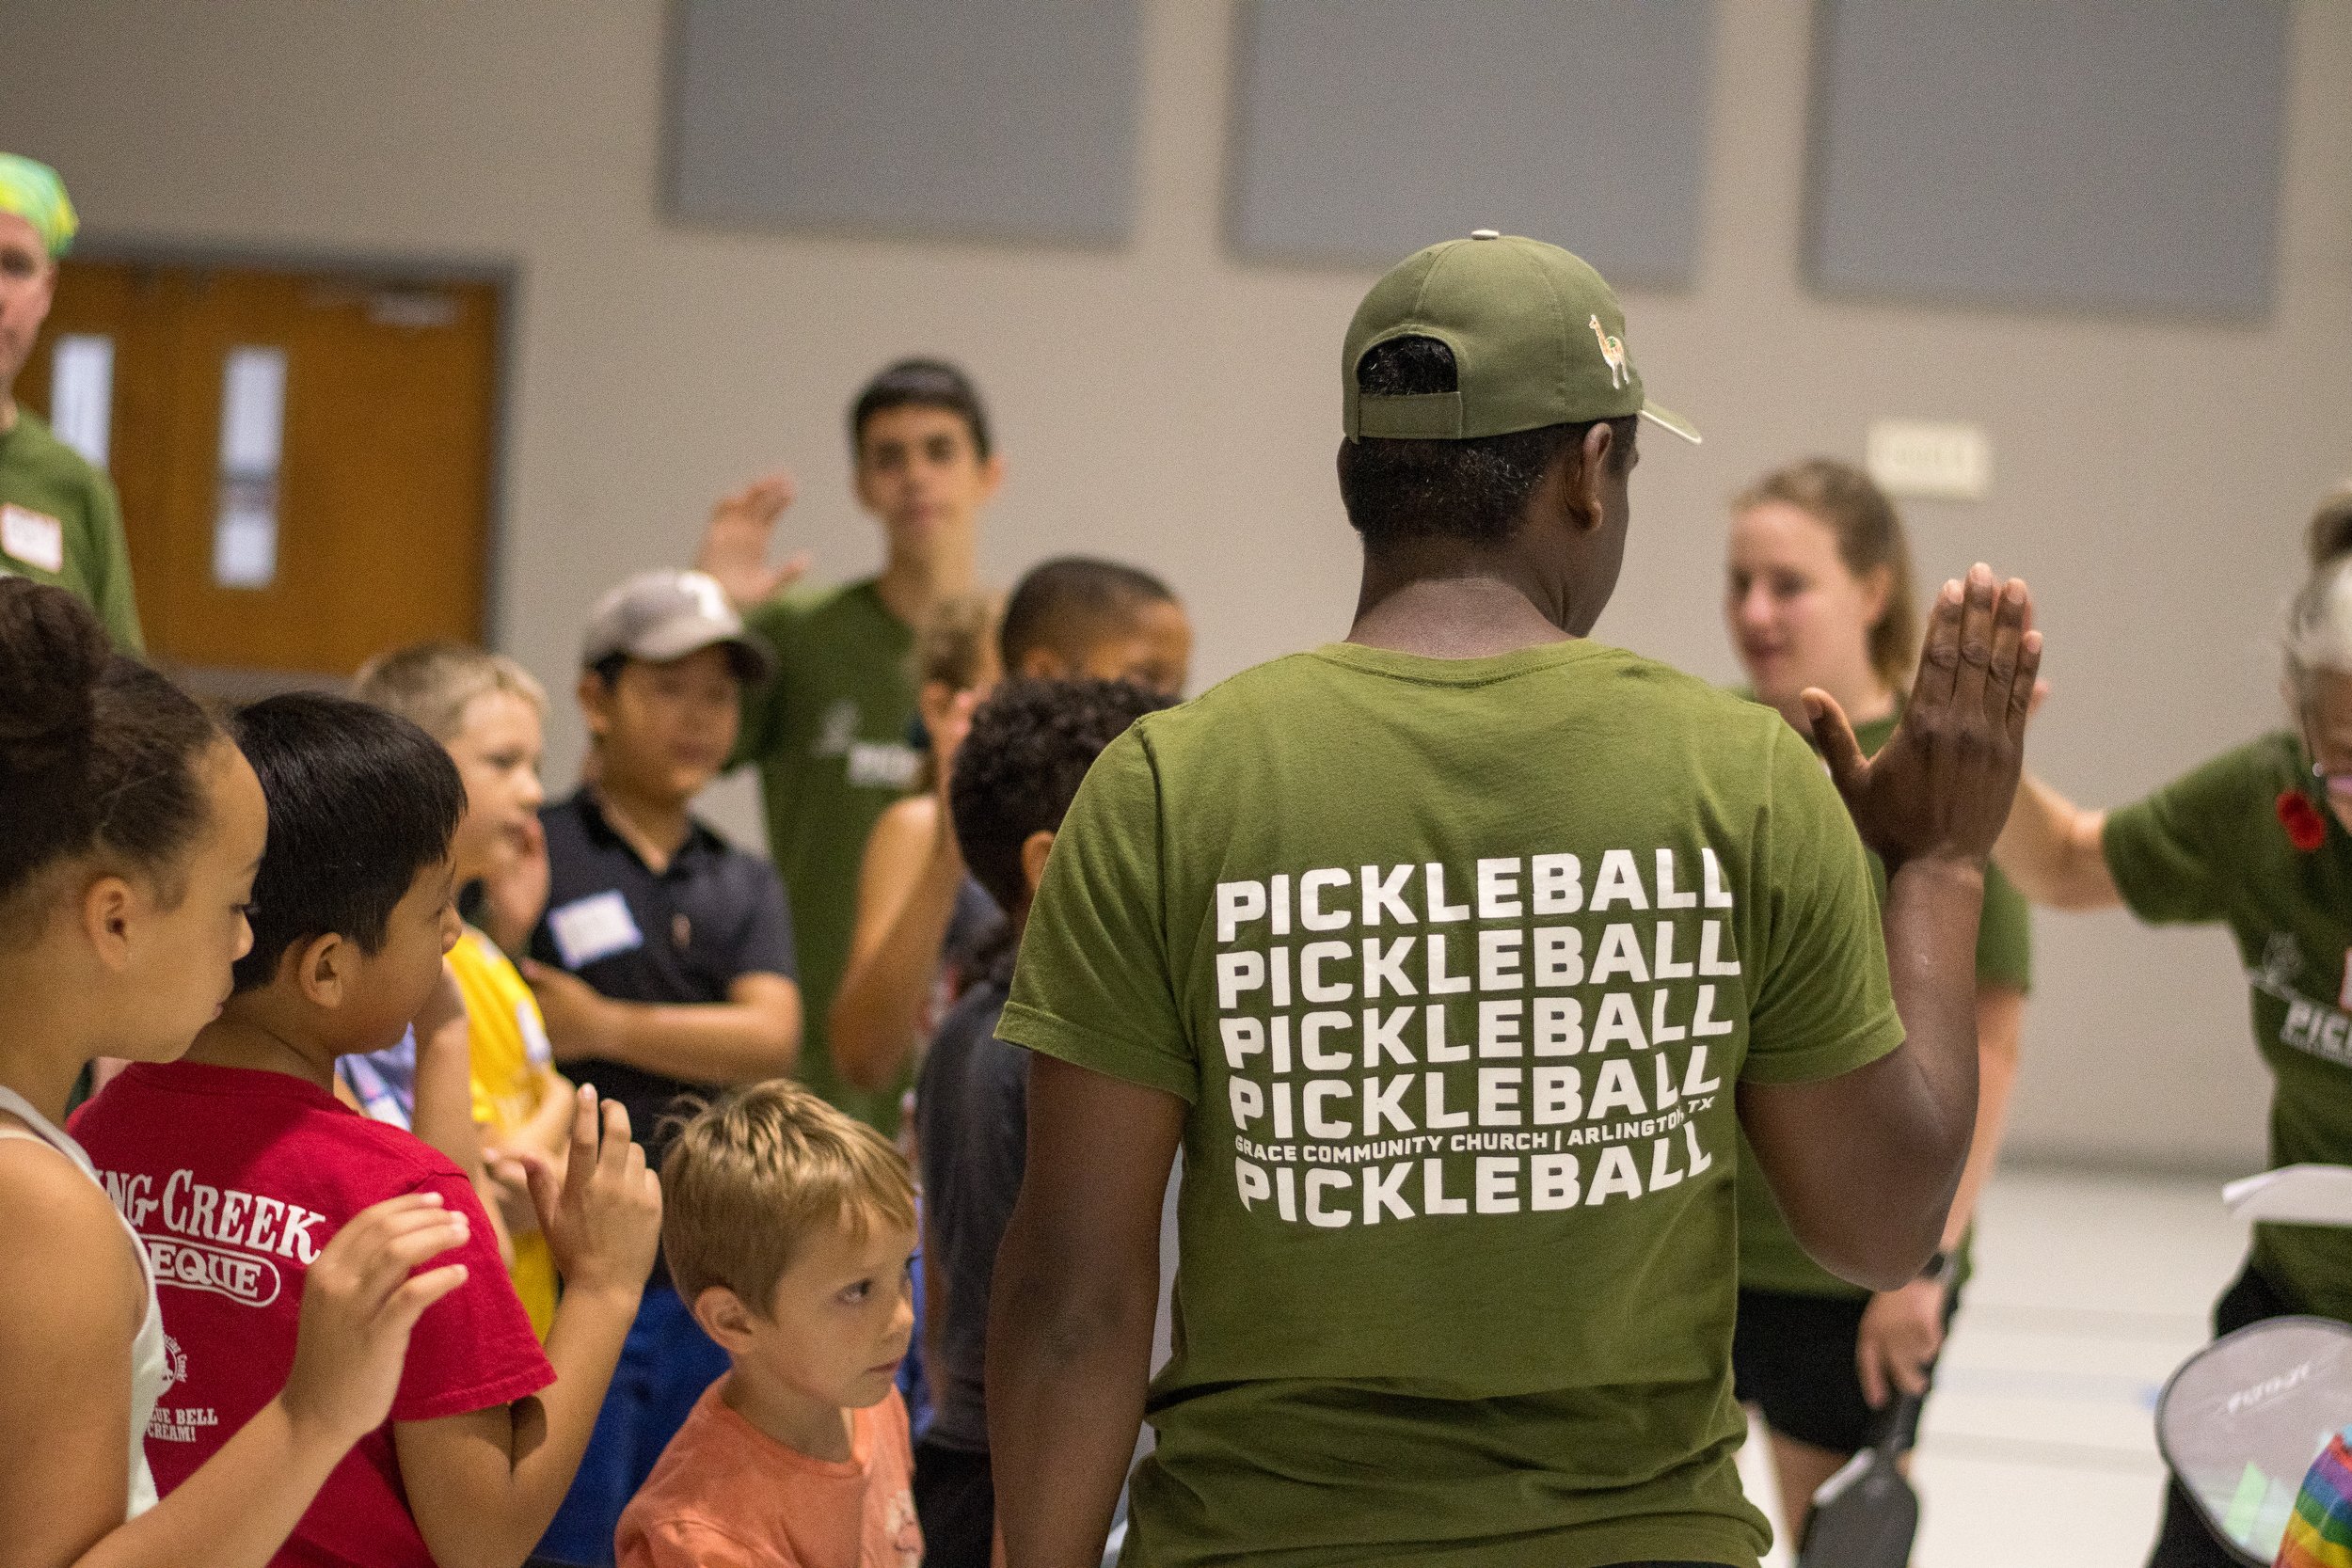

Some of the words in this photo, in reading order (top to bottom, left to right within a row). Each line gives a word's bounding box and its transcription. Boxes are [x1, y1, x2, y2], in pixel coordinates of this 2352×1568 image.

[1216, 847, 1734, 942] PICKLEBALL
[1216, 920, 1742, 1009] PICKLEBALL
[1218, 984, 1735, 1073] PICKLEBALL
[1228, 1044, 1721, 1140] PICKLEBALL
[1234, 1133, 1297, 1163] GRACE
[1302, 1135, 1443, 1164] COMMUNITY
[1450, 1131, 1548, 1152] CHURCH
[1688, 1096, 1715, 1114] TX
[163, 1169, 326, 1265] CREEK
[1234, 1119, 1712, 1228] PICKLEBALL
[175, 1407, 218, 1426] BELL
